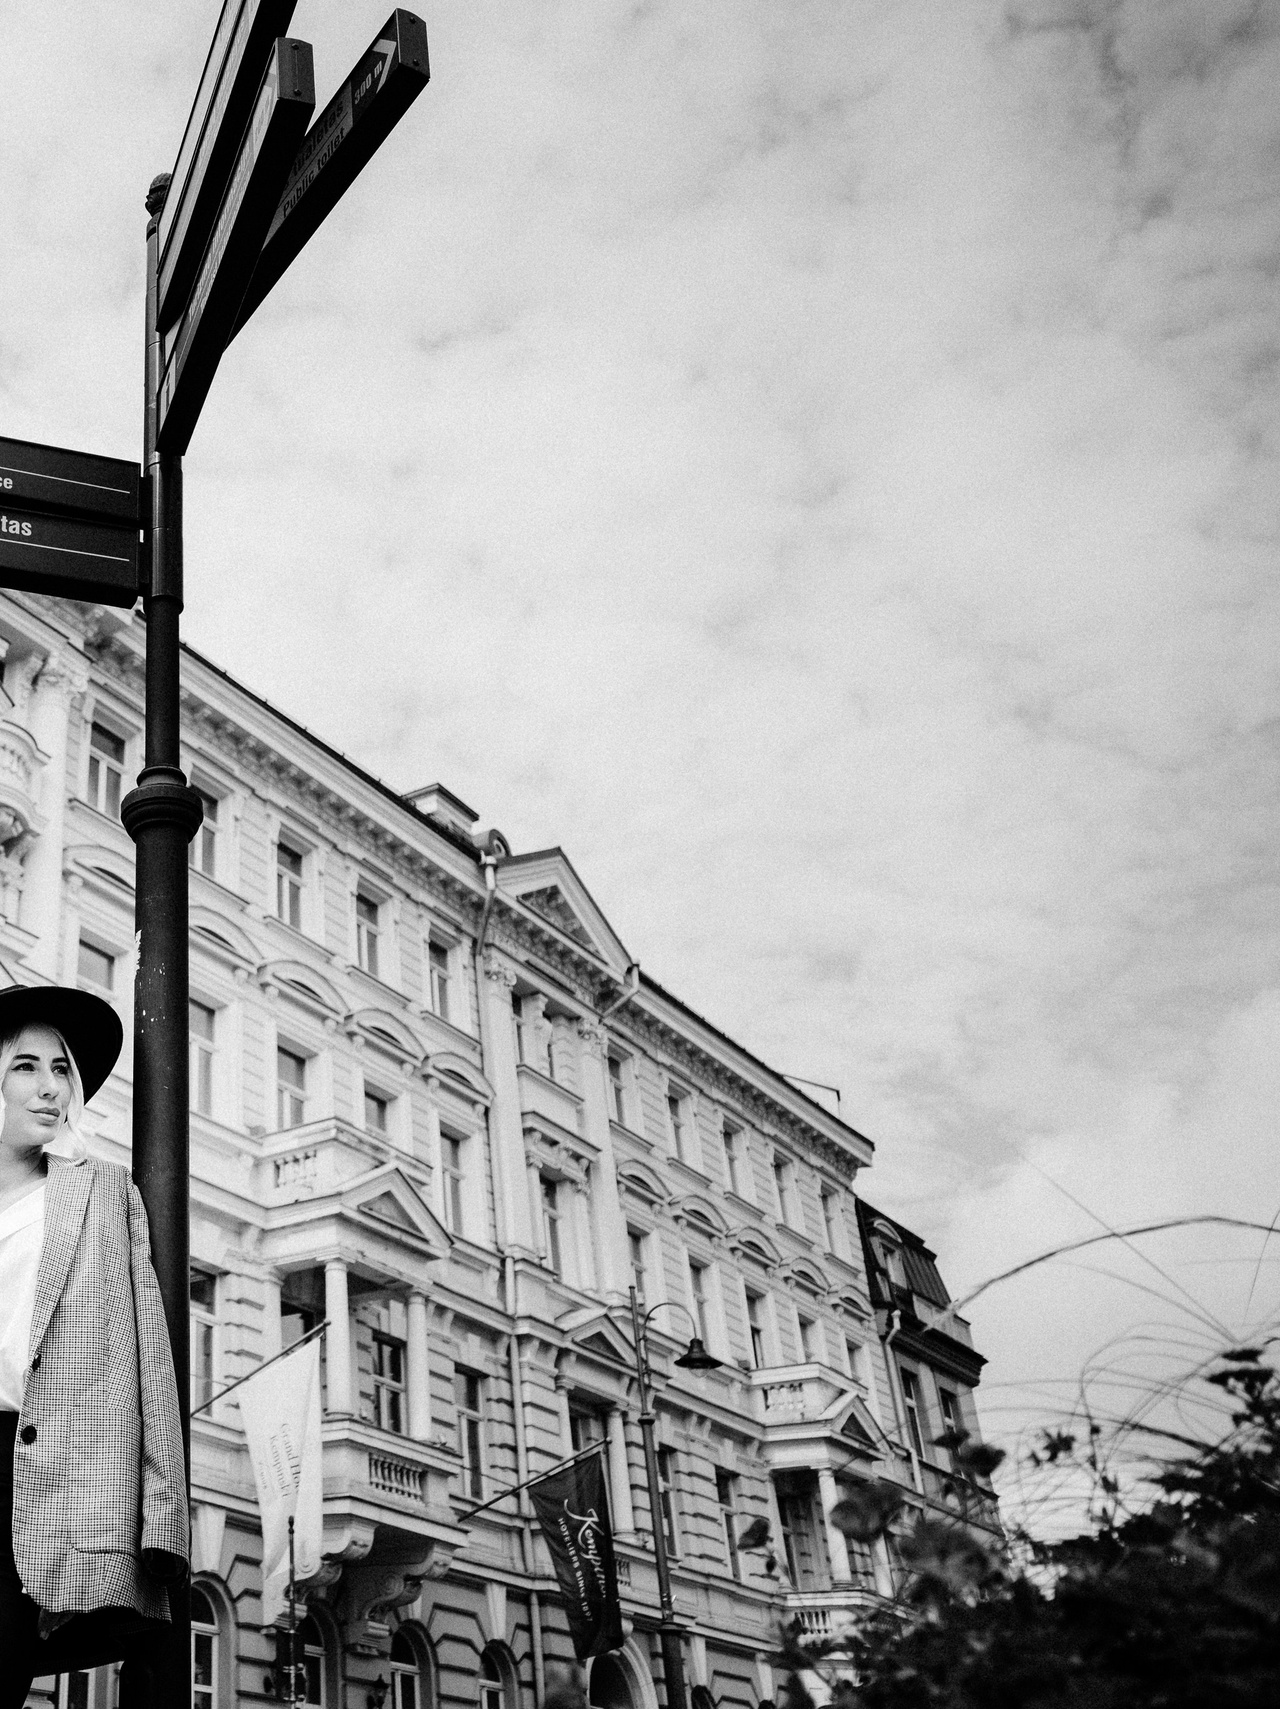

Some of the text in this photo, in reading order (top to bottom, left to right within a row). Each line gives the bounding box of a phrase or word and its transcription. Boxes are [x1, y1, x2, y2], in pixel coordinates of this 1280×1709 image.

[354, 60, 383, 105] 300 m
[283, 126, 346, 219] Public toilet
[558, 1517, 581, 1569] HOTELIERS
